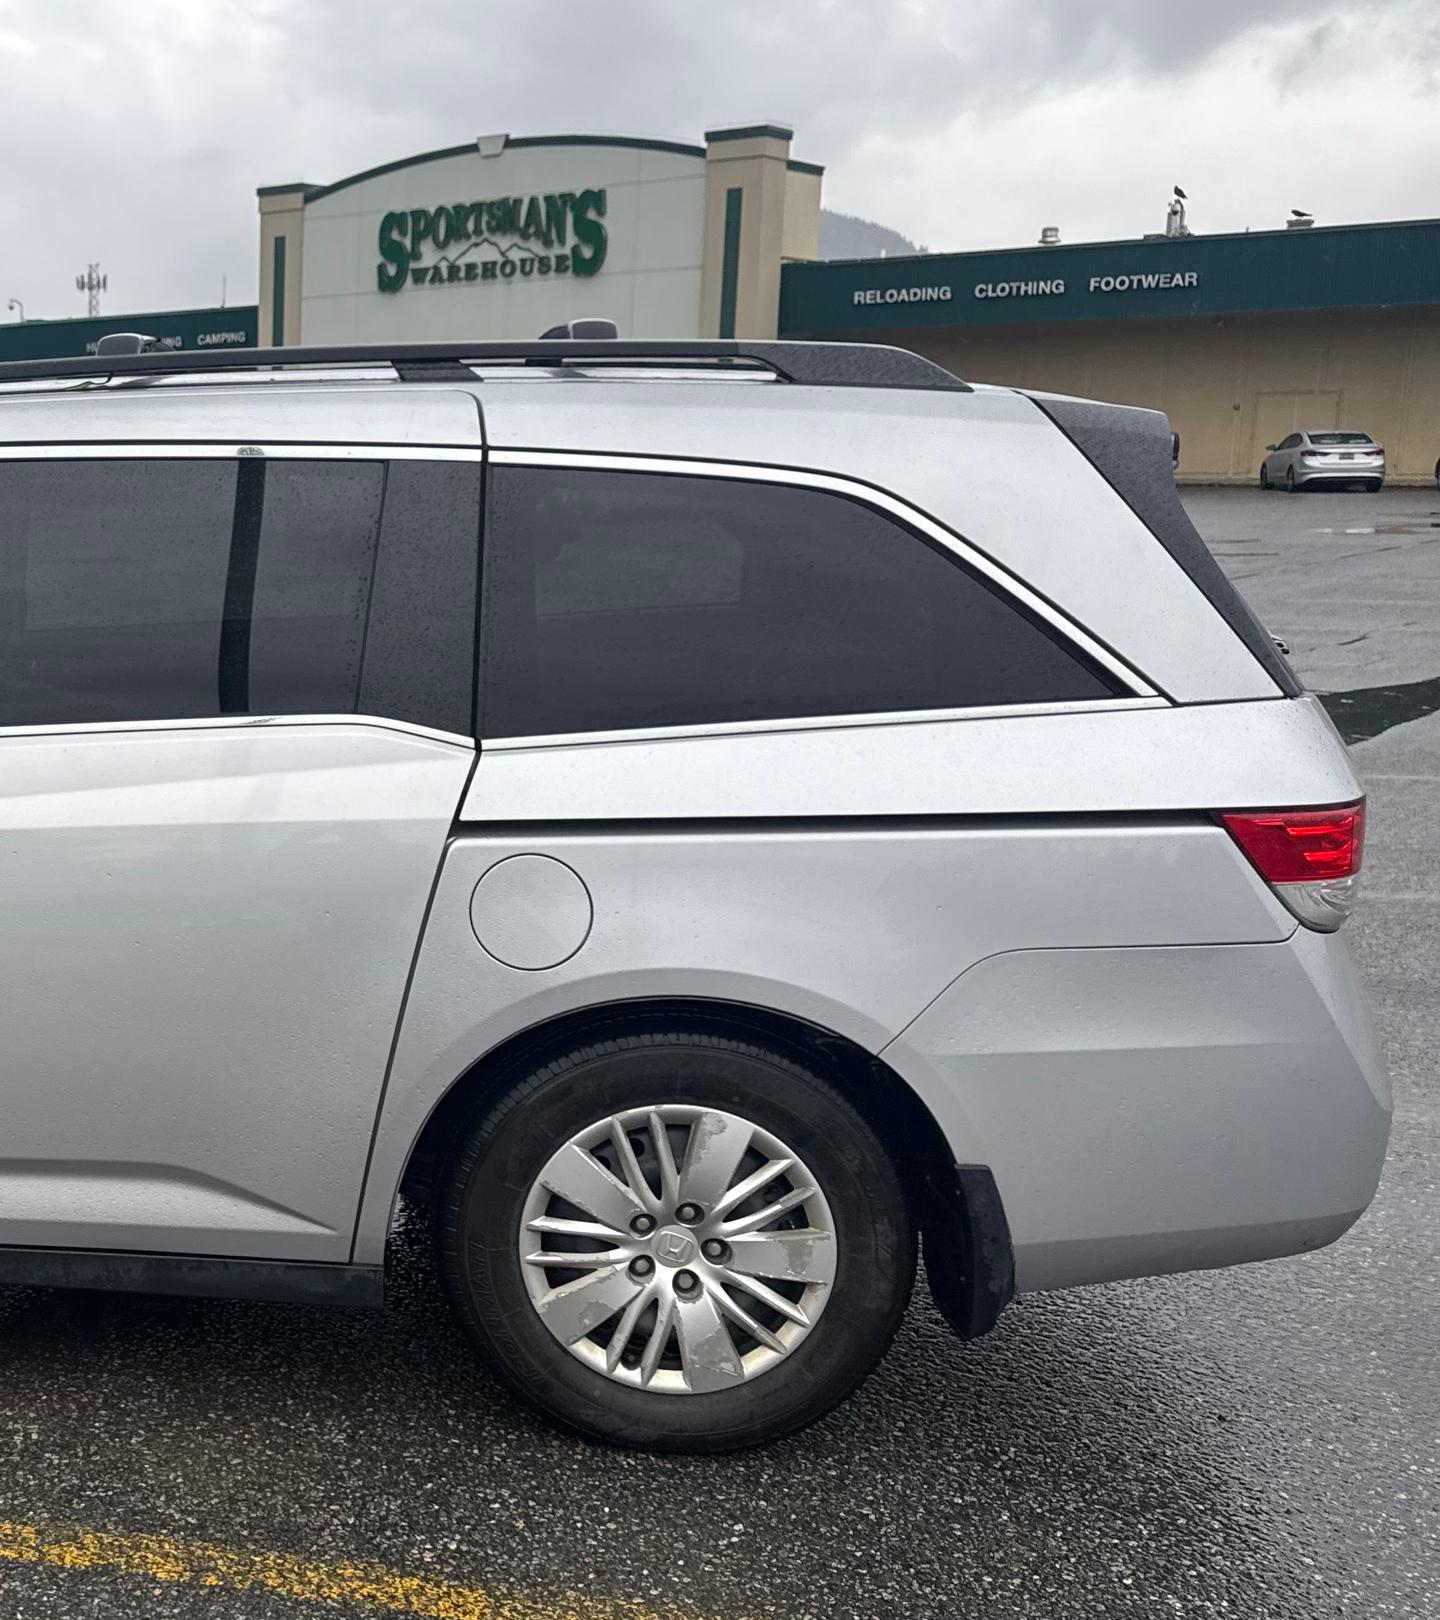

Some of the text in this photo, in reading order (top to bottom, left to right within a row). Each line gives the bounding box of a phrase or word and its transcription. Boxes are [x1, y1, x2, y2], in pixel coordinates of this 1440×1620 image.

[377, 189, 607, 293] SPORTSMAN'S
[410, 255, 571, 285] WAREHOUSE
[853, 272, 1198, 305] RELOADING CLOTHING FOOTWEAR
[196, 331, 246, 346] CAMPING
